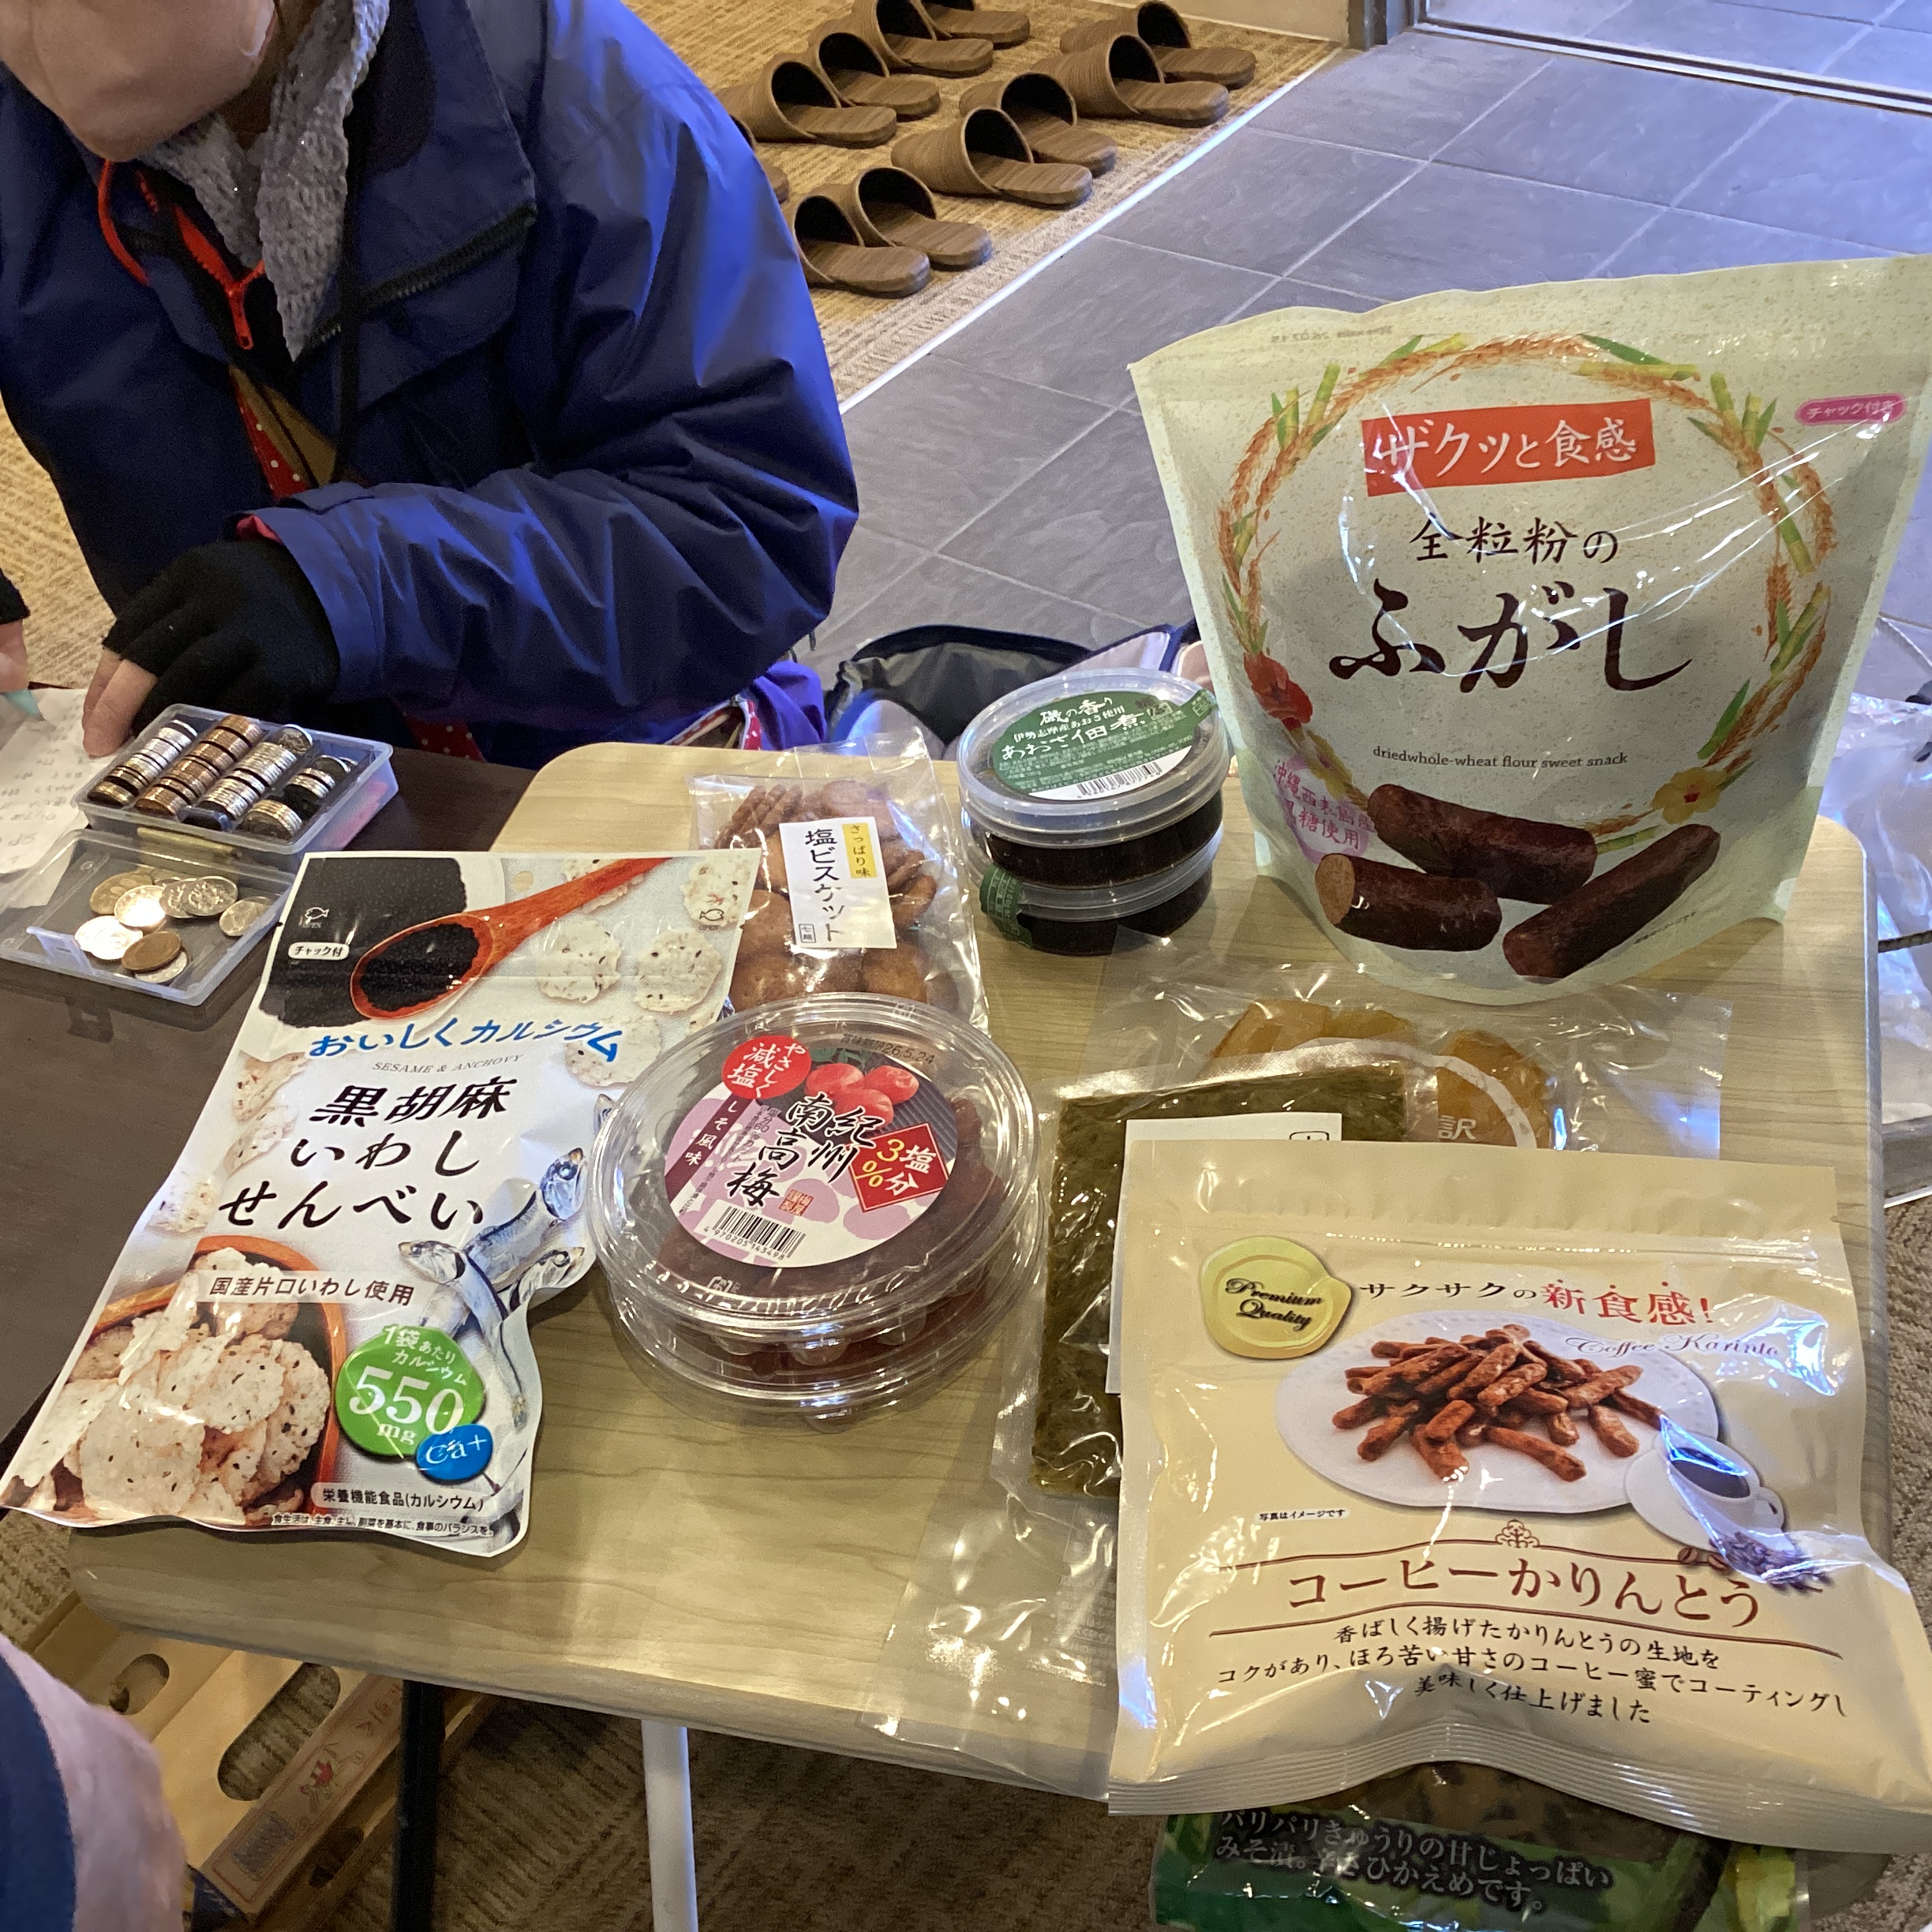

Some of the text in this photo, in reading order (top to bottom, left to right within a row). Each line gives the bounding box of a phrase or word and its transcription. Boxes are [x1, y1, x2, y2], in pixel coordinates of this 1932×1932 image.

[1377, 416, 1637, 477] ザクッと食感
[1410, 515, 1619, 564] 全粒粉の
[1329, 578, 1693, 694] ふがし
[1039, 696, 1114, 725] 磯の香り
[1372, 745, 1628, 769] driedwhole-wheat flour sweet snack
[849, 825, 871, 878] さっぱり味
[804, 828, 845, 942] 塩ビスケット
[294, 945, 343, 957] チャック付
[308, 1017, 623, 1063] おいしくカルシウム
[372, 1054, 526, 1074] SESAME & ANCHOVY
[726, 1041, 781, 1089] 減塩
[754, 1042, 807, 1099] やさしく
[309, 1075, 519, 1128] 黒胡麻
[684, 1099, 739, 1166] しそ風味
[725, 1091, 833, 1208] 南高梅
[810, 1106, 886, 1185] 紀州
[1437, 1114, 1477, 1141] 訳
[290, 1129, 480, 1178] いわし
[883, 1144, 938, 1196] 塩分
[218, 1180, 485, 1231] せんべい
[713, 1230, 749, 1247] 970205
[750, 1243, 785, 1260] 143498
[209, 1275, 415, 1307] 国産片口いわし使用
[1225, 1277, 1324, 1306] Premium
[1236, 1298, 1312, 1332] Quality
[1359, 1279, 1715, 1326] サクサクの新食感!
[384, 1326, 456, 1365] 1袋あたり
[1565, 1336, 1656, 1359] Coffee
[348, 1365, 465, 1436] 550
[376, 1423, 418, 1446] mg
[321, 1488, 485, 1513] 栄養機能食品(カルシウム)
[1289, 1557, 1760, 1628] コーヒーかりんとう
[1333, 1614, 1720, 1670] 香ばしく揚げたかりんとうの生地を
[1218, 1644, 1848, 1718] コクがあり、ほろ苦い甘さのコーヒー蜜でコーティングし
[1413, 1671, 1652, 1724] 美味しく仕上げました
